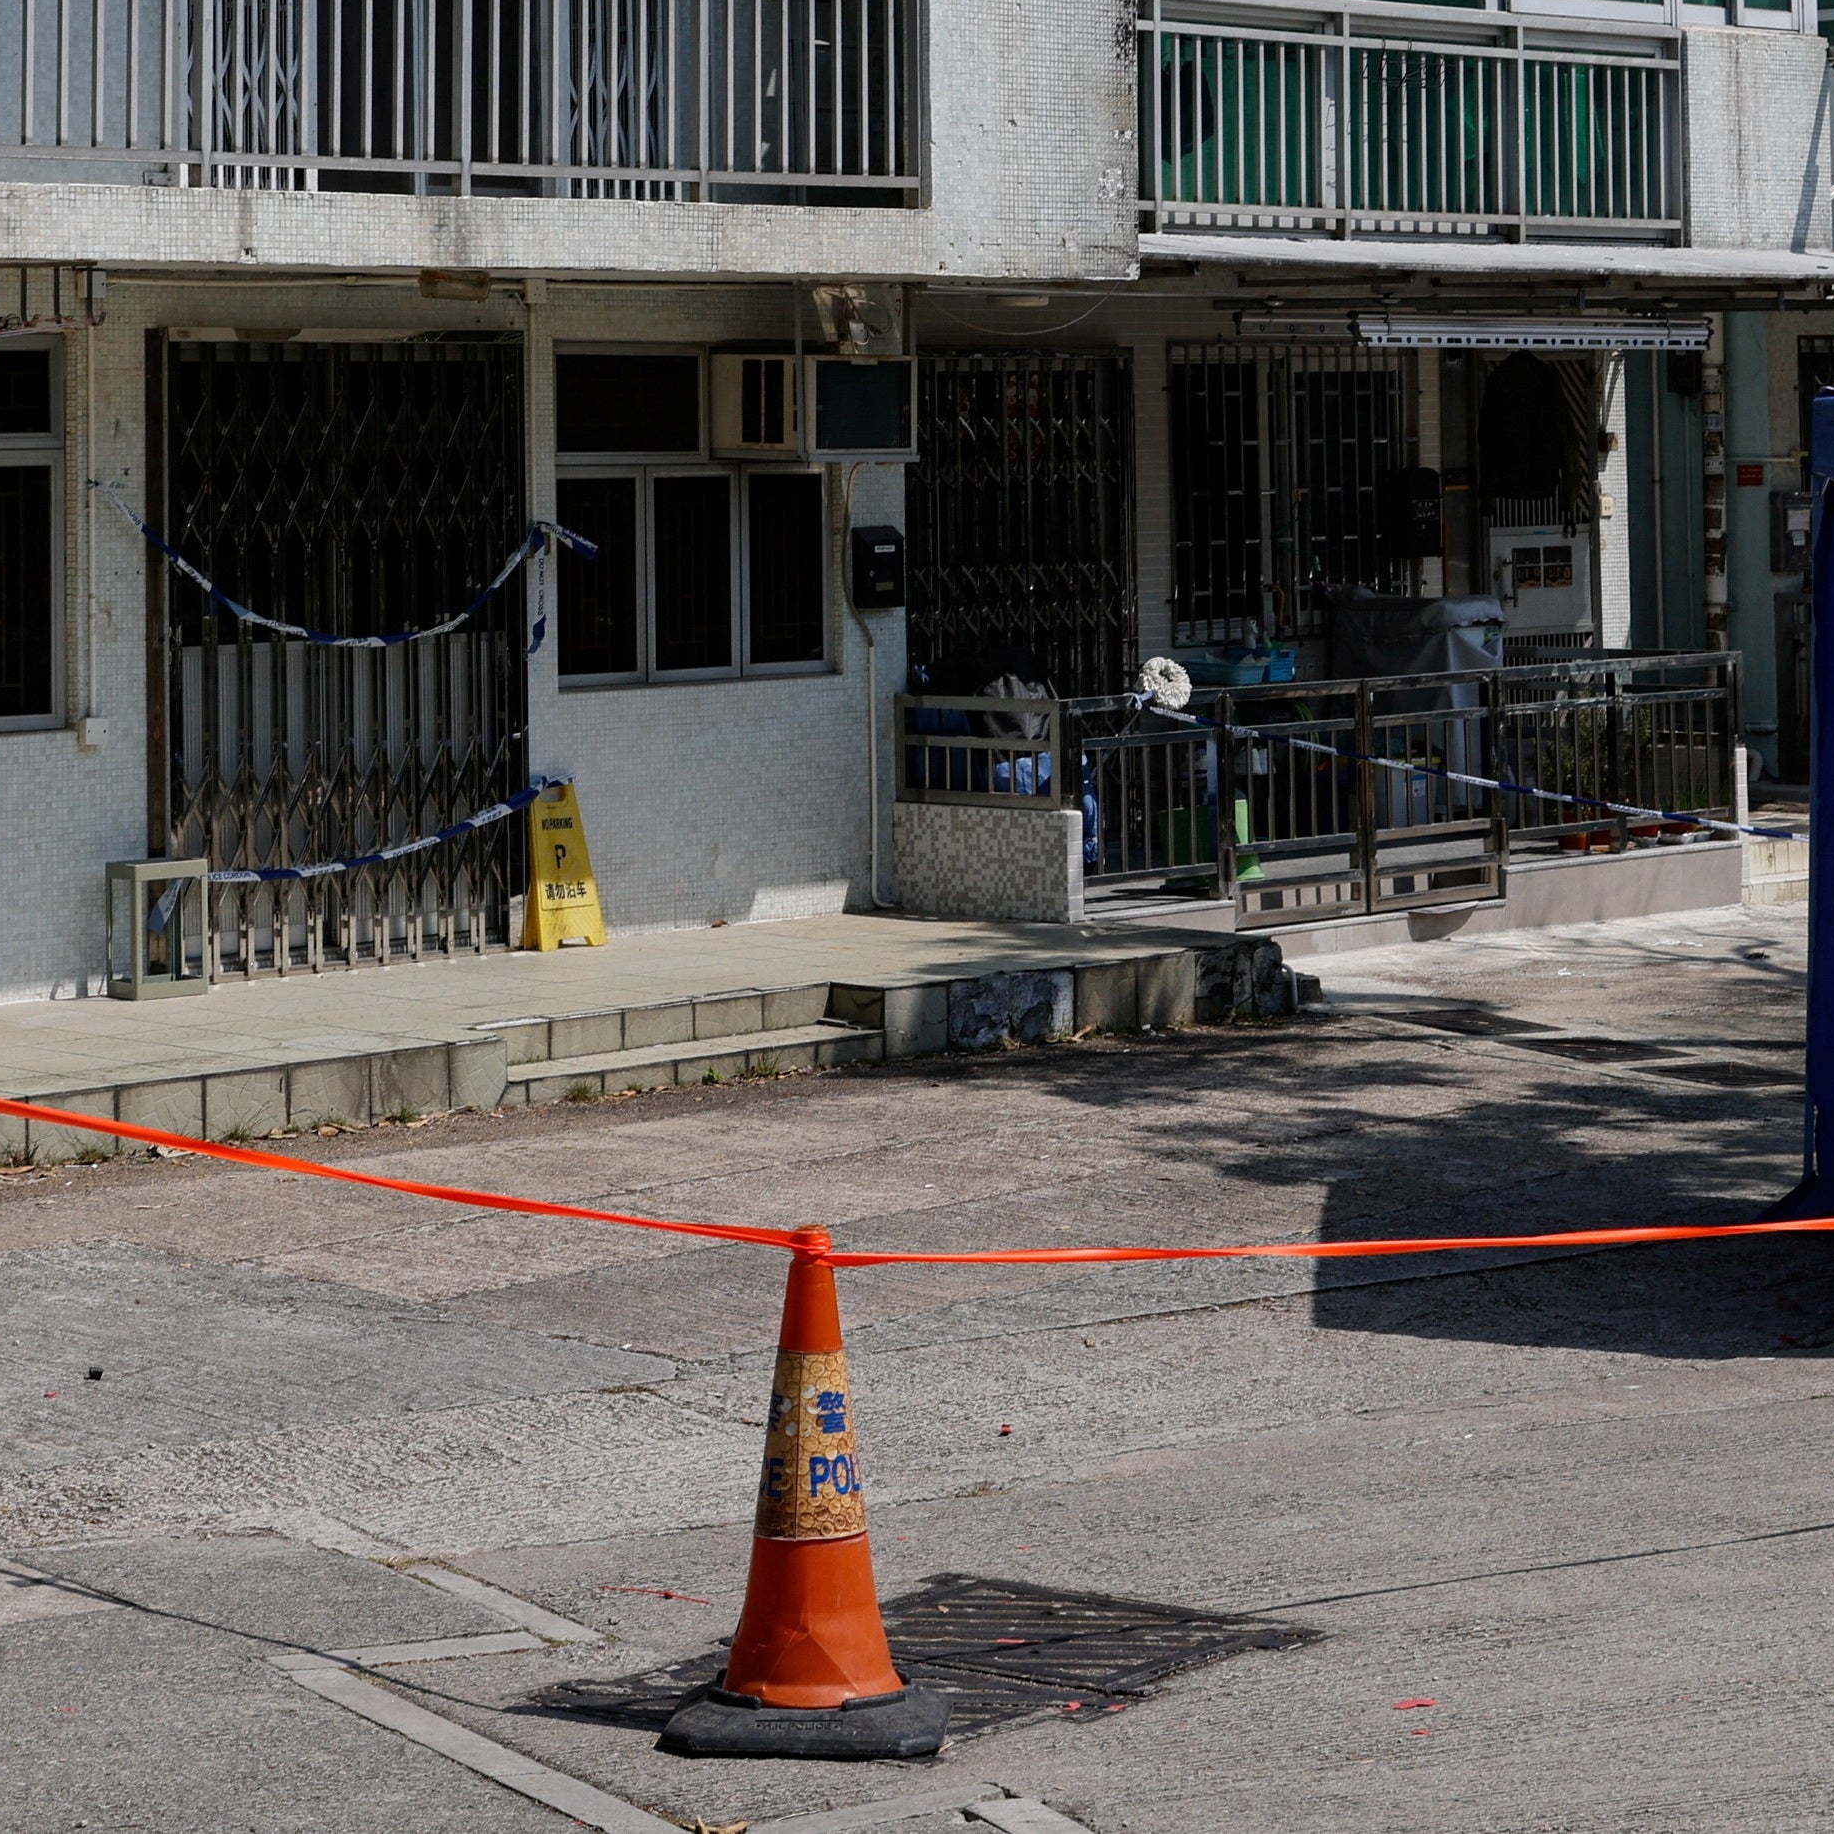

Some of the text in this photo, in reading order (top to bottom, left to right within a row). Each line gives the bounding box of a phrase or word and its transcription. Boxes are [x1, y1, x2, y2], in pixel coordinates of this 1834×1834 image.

[542, 817, 573, 831] NO PARKING
[554, 844, 567, 870] P
[545, 881, 587, 901] 请勿泊车
